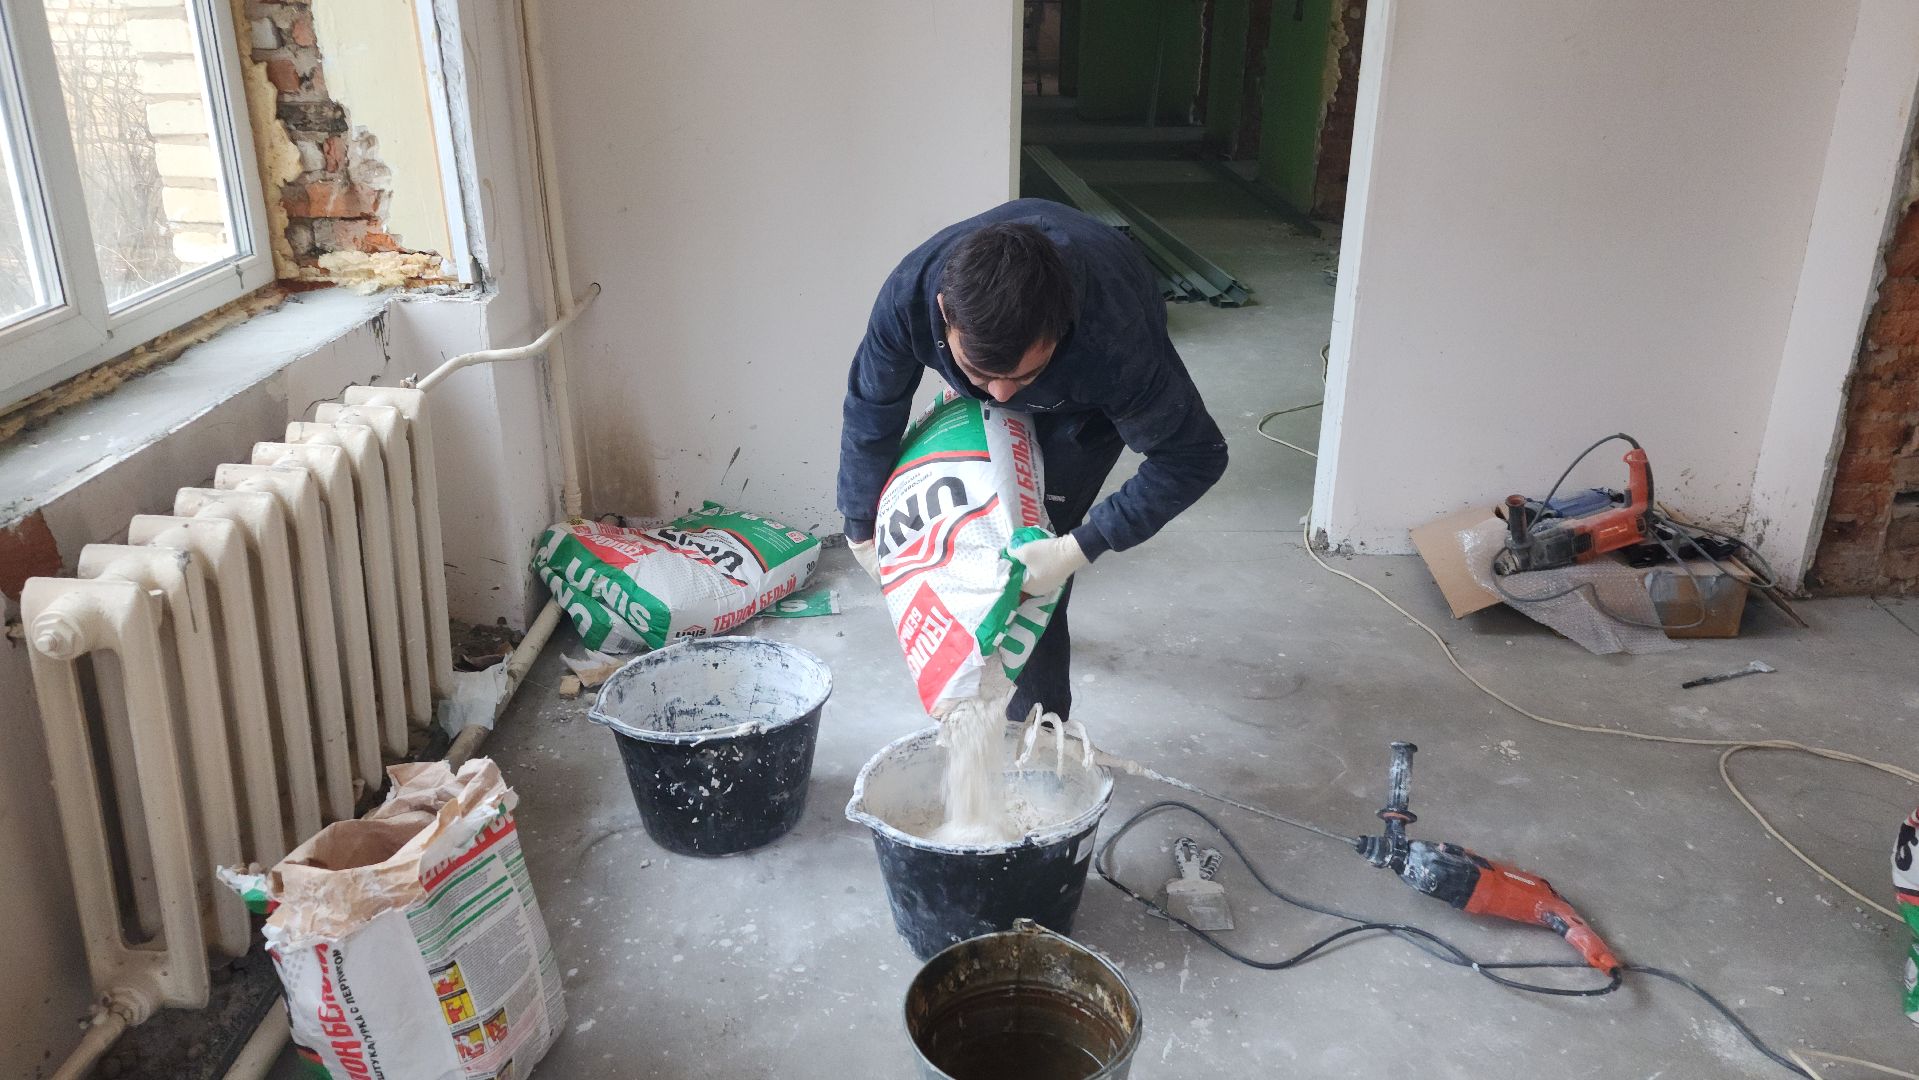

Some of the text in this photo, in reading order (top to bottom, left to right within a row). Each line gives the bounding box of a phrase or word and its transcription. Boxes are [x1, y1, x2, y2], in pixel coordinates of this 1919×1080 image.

[1003, 417, 1035, 491] БЕЛЫЙ
[878, 476, 968, 560] UNI
[565, 557, 651, 633] UNIS
[760, 573, 797, 608] БЕЛЫЙ
[907, 605, 952, 680] ТЕПЛО
